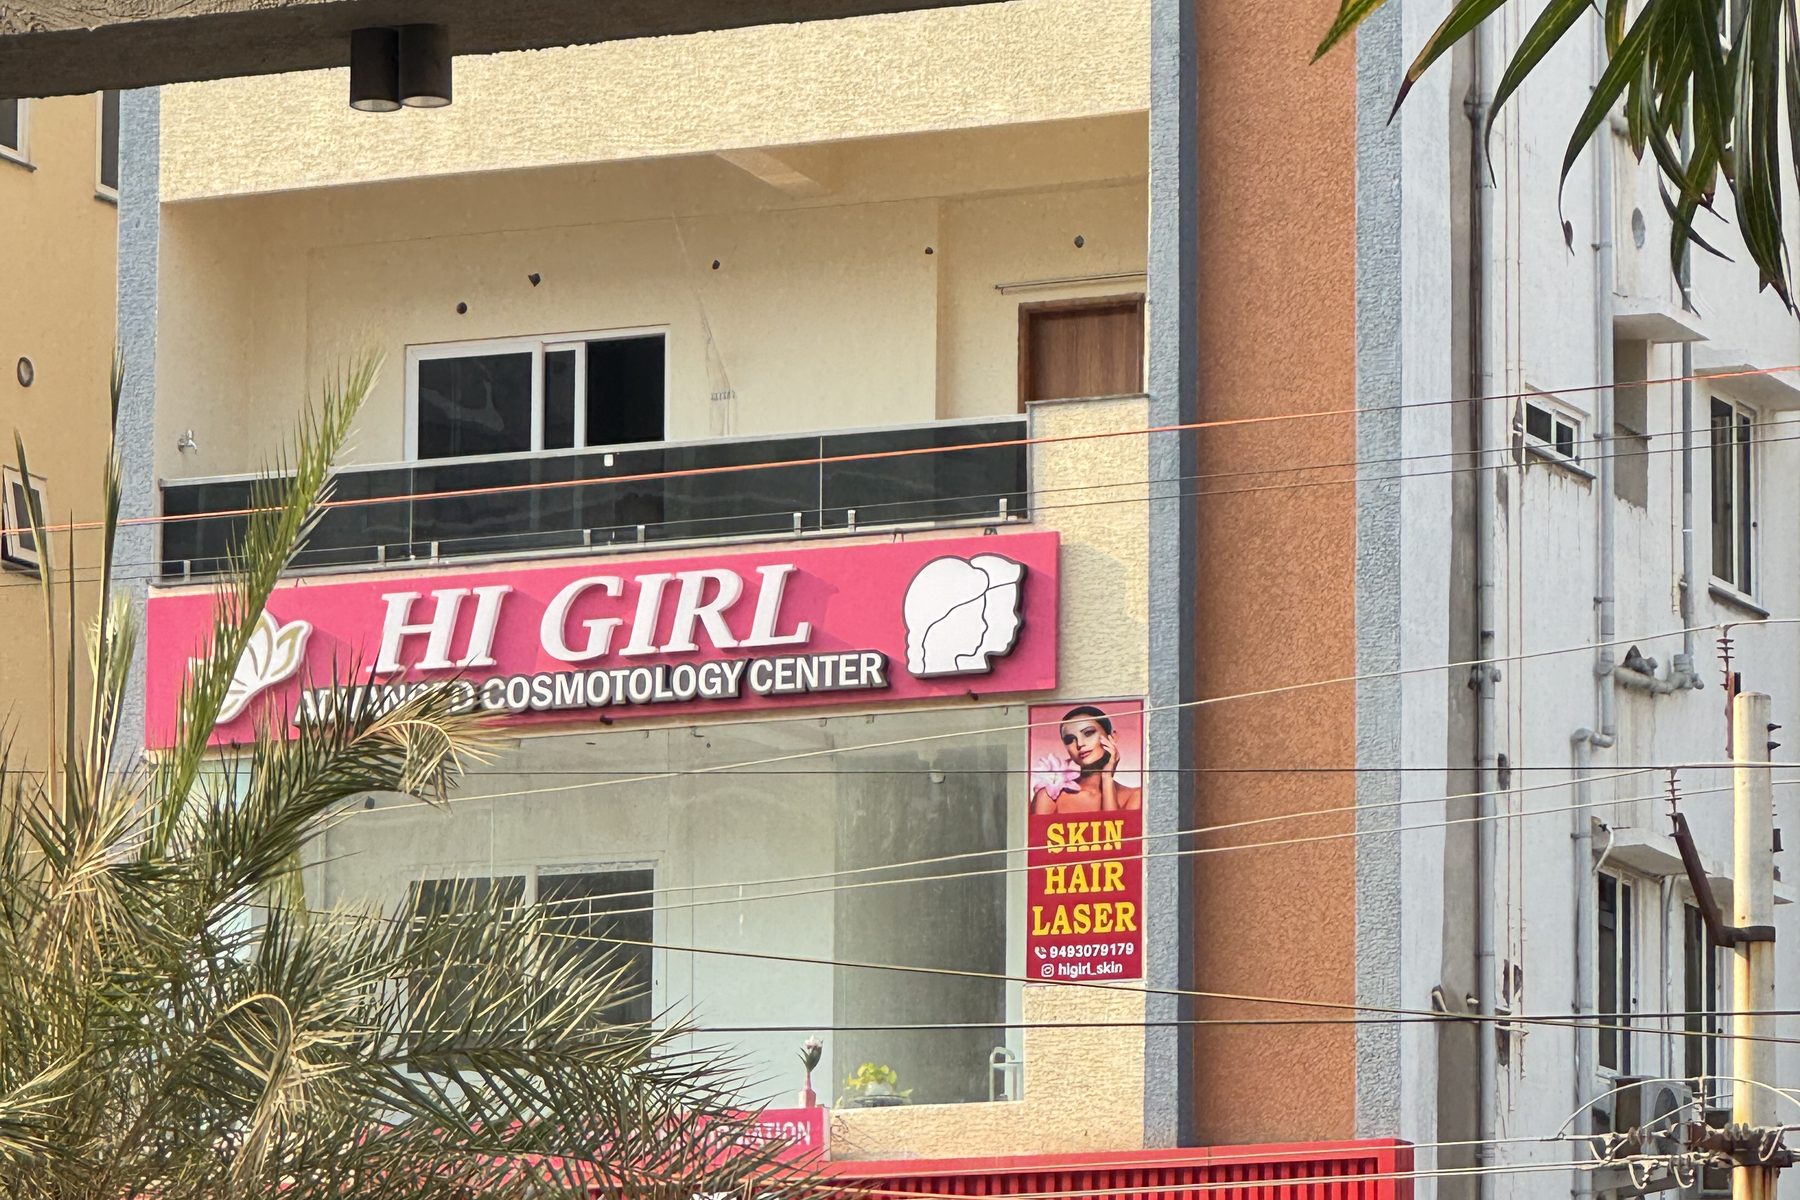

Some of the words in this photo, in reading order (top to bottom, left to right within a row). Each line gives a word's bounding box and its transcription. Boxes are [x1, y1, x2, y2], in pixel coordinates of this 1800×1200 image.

[366, 584, 513, 673] HI
[540, 563, 812, 662] GIRL
[483, 660, 746, 710] COSMOTOLOGY
[750, 653, 883, 692] CENTER
[1046, 819, 1125, 854] SKIN
[1044, 861, 1126, 895] HAIR
[1032, 901, 1137, 936] LASER
[1049, 942, 1134, 959] 9493079179
[1058, 960, 1123, 978] higirl_skin
